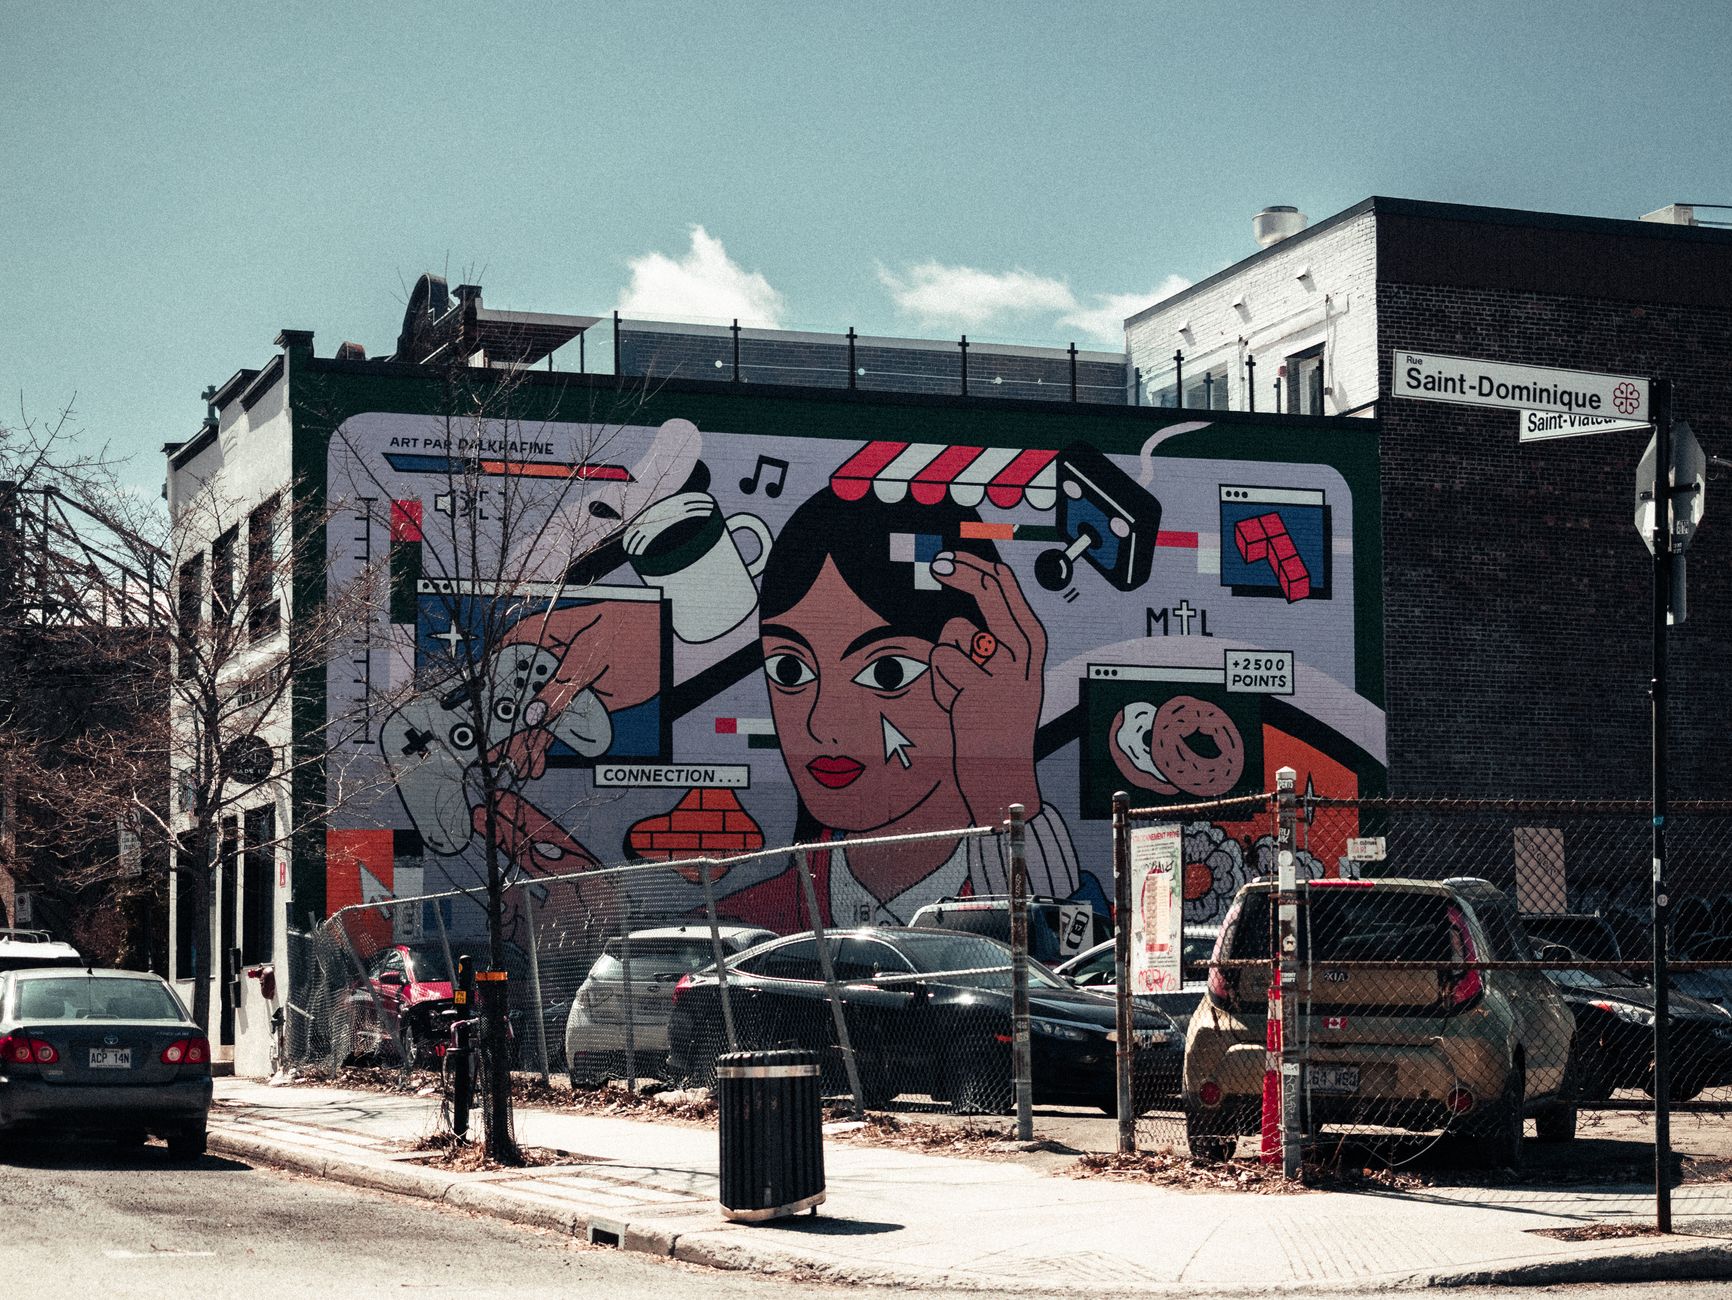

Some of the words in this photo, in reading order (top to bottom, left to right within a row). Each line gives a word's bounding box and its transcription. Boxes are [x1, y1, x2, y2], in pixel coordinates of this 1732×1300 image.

[1406, 355, 1423, 366] Rue
[1405, 366, 1601, 411] Saint-Dominique
[1527, 411, 1616, 432] Saint-Via
[389, 437, 418, 448] ART
[1232, 658, 1285, 672] +2500
[1232, 674, 1287, 688] POINTS
[91, 1053, 107, 1063] ACP
[114, 1053, 129, 1063] 14N
